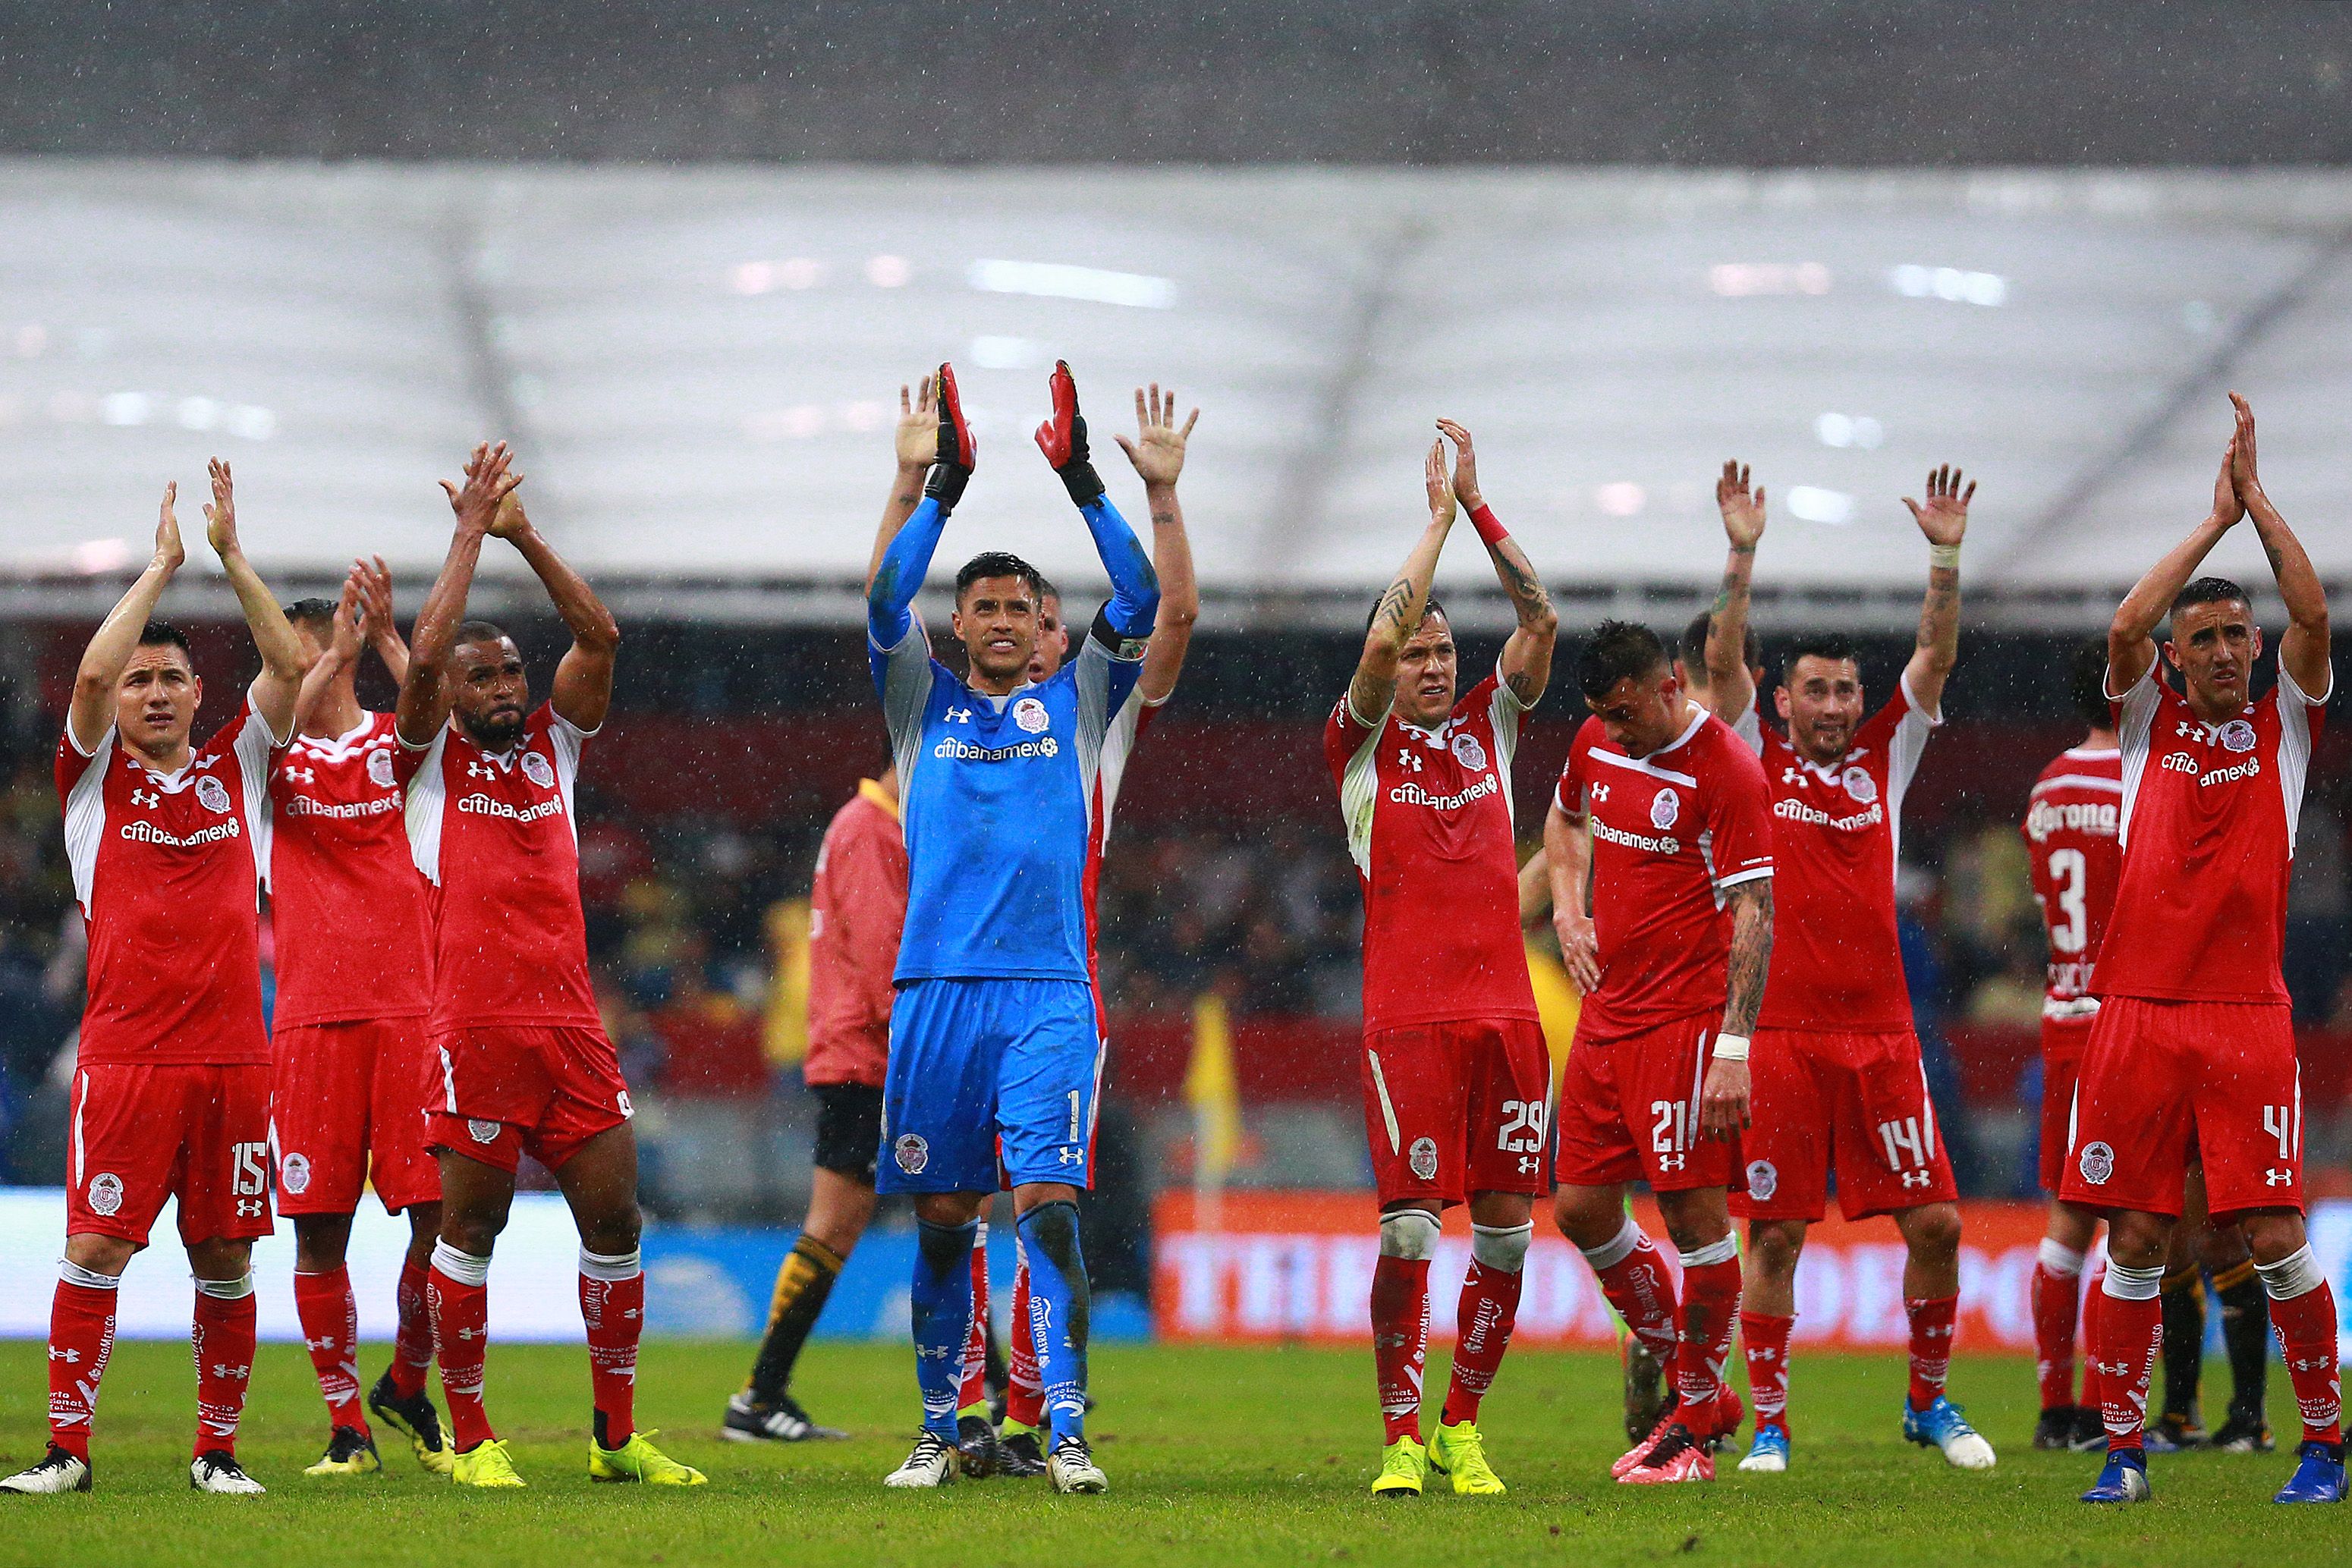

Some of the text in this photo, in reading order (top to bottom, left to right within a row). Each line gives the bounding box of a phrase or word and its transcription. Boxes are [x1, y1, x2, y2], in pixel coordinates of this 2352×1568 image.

[934, 737, 1041, 761] citibanamex
[2162, 752, 2247, 787] citibamex
[285, 795, 393, 819] citibanamex
[2049, 848, 2086, 953] 3
[1068, 1089, 1080, 1142] 1
[1497, 1100, 1544, 1152] 29
[1651, 1100, 1686, 1152] 21
[2263, 1105, 2288, 1159] 4
[231, 1142, 266, 1196] 15
[1877, 1117, 1926, 1172] 14
[94, 1315, 115, 1370] AEROMEXICO
[1030, 1296, 1049, 1353] AEROMEXICO
